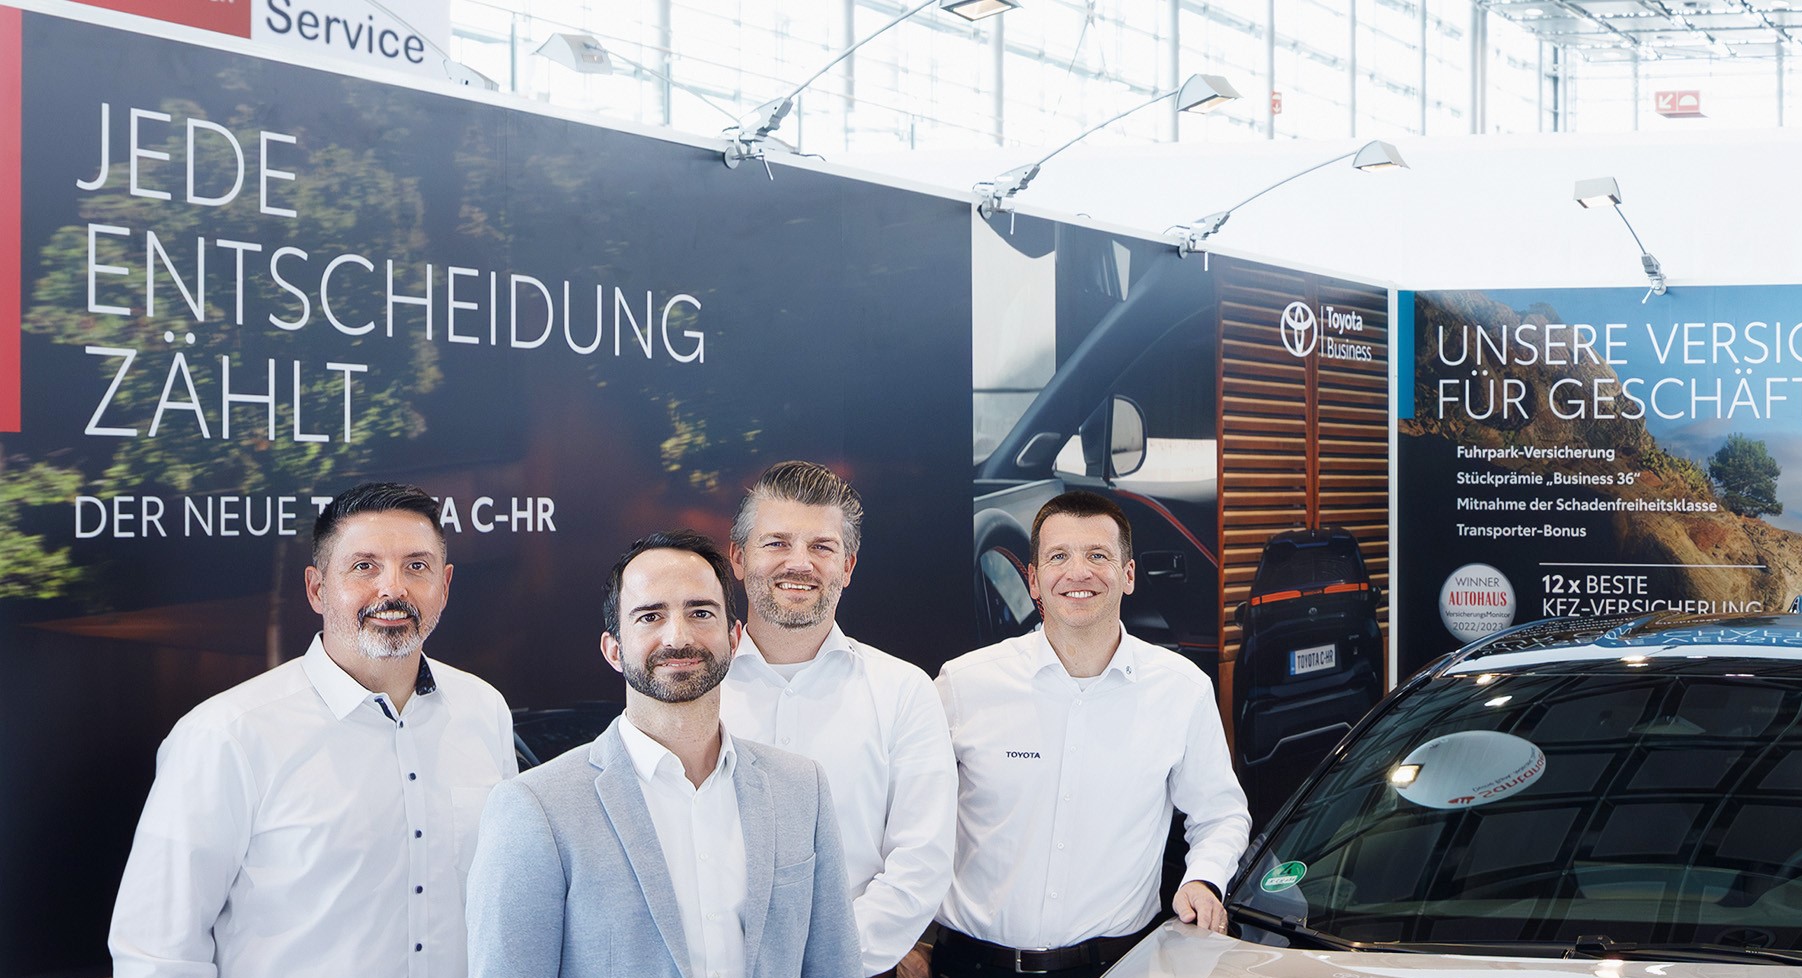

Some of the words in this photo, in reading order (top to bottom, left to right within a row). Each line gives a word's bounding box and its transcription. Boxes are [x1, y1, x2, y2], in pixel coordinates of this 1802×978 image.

[266, 0, 424, 64] Service
[76, 103, 297, 217] JEDE
[86, 224, 705, 363] ENTSCHEIDUNG
[1326, 306, 1363, 335] Toyota
[1327, 337, 1372, 361] Business
[1438, 322, 1628, 366] UNSERE
[84, 331, 368, 443] ZÄHLT
[1438, 369, 1530, 420] FÜR
[1457, 446, 1615, 462] Fuhrpark-Versicherung
[1456, 471, 1543, 487] Stückprämie
[1546, 472, 1614, 486] „Business
[1616, 472, 1641, 486] 36“
[1457, 498, 1526, 511] Mitnahme
[1529, 497, 1553, 511] der
[1556, 498, 1718, 513] Schadenfreiheitsklasse
[75, 496, 166, 539] DER
[184, 496, 297, 536] NEUE
[471, 496, 556, 533] C-HR
[1456, 524, 1587, 540] Transporter-Bonus
[1455, 577, 1500, 588] WINNER
[1542, 574, 1565, 594] 12
[1568, 579, 1581, 594] x
[1586, 575, 1648, 595] BESTE
[1448, 591, 1507, 607] AUTOHAUS
[1543, 598, 1762, 617] KFZ-VERSICHERUNG
[1445, 610, 1511, 619] VersicherungsMonitor
[1453, 621, 1504, 633] 2022/2023
[1006, 751, 1041, 759] TOYOTA
